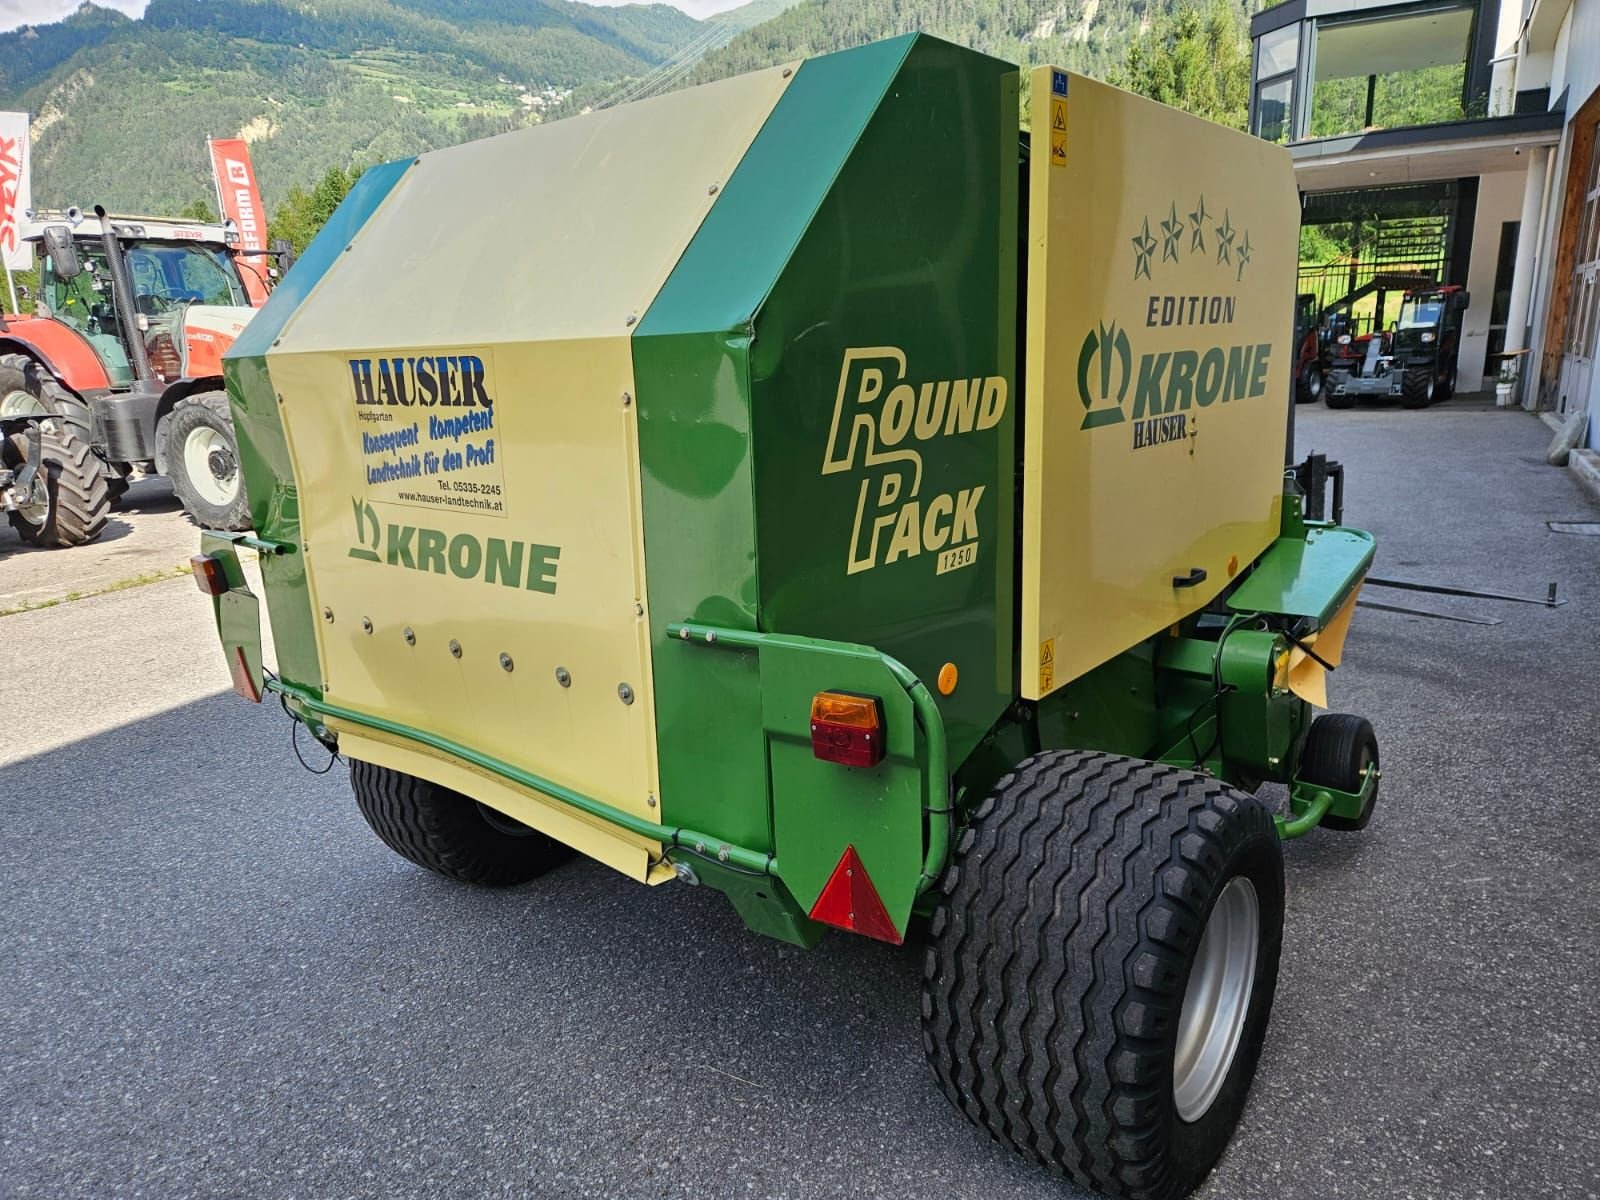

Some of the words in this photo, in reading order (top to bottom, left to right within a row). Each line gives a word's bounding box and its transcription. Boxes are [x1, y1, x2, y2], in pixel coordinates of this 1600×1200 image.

[173, 230, 202, 239] STEYR
[1146, 296, 1236, 327] EDITION
[349, 356, 493, 408] HAUSER
[1132, 343, 1272, 420] KRONE
[358, 411, 393, 422] Hopfgarten
[363, 422, 419, 456] Konsequent
[429, 404, 494, 442] Kompetent
[822, 346, 1008, 475] ROUND
[1133, 413, 1187, 450] HAUSER
[367, 454, 421, 485] Landtechnik
[424, 450, 440, 475] für
[442, 448, 463, 472] den
[466, 439, 495, 467] Profi
[398, 493, 503, 512] www.hauser-landtechnik.at
[438, 480, 452, 491] Tel.
[453, 482, 501, 496] 05335-2245
[847, 449, 986, 575] PACK
[387, 524, 561, 595] KRONE
[943, 547, 971, 571] 1250
